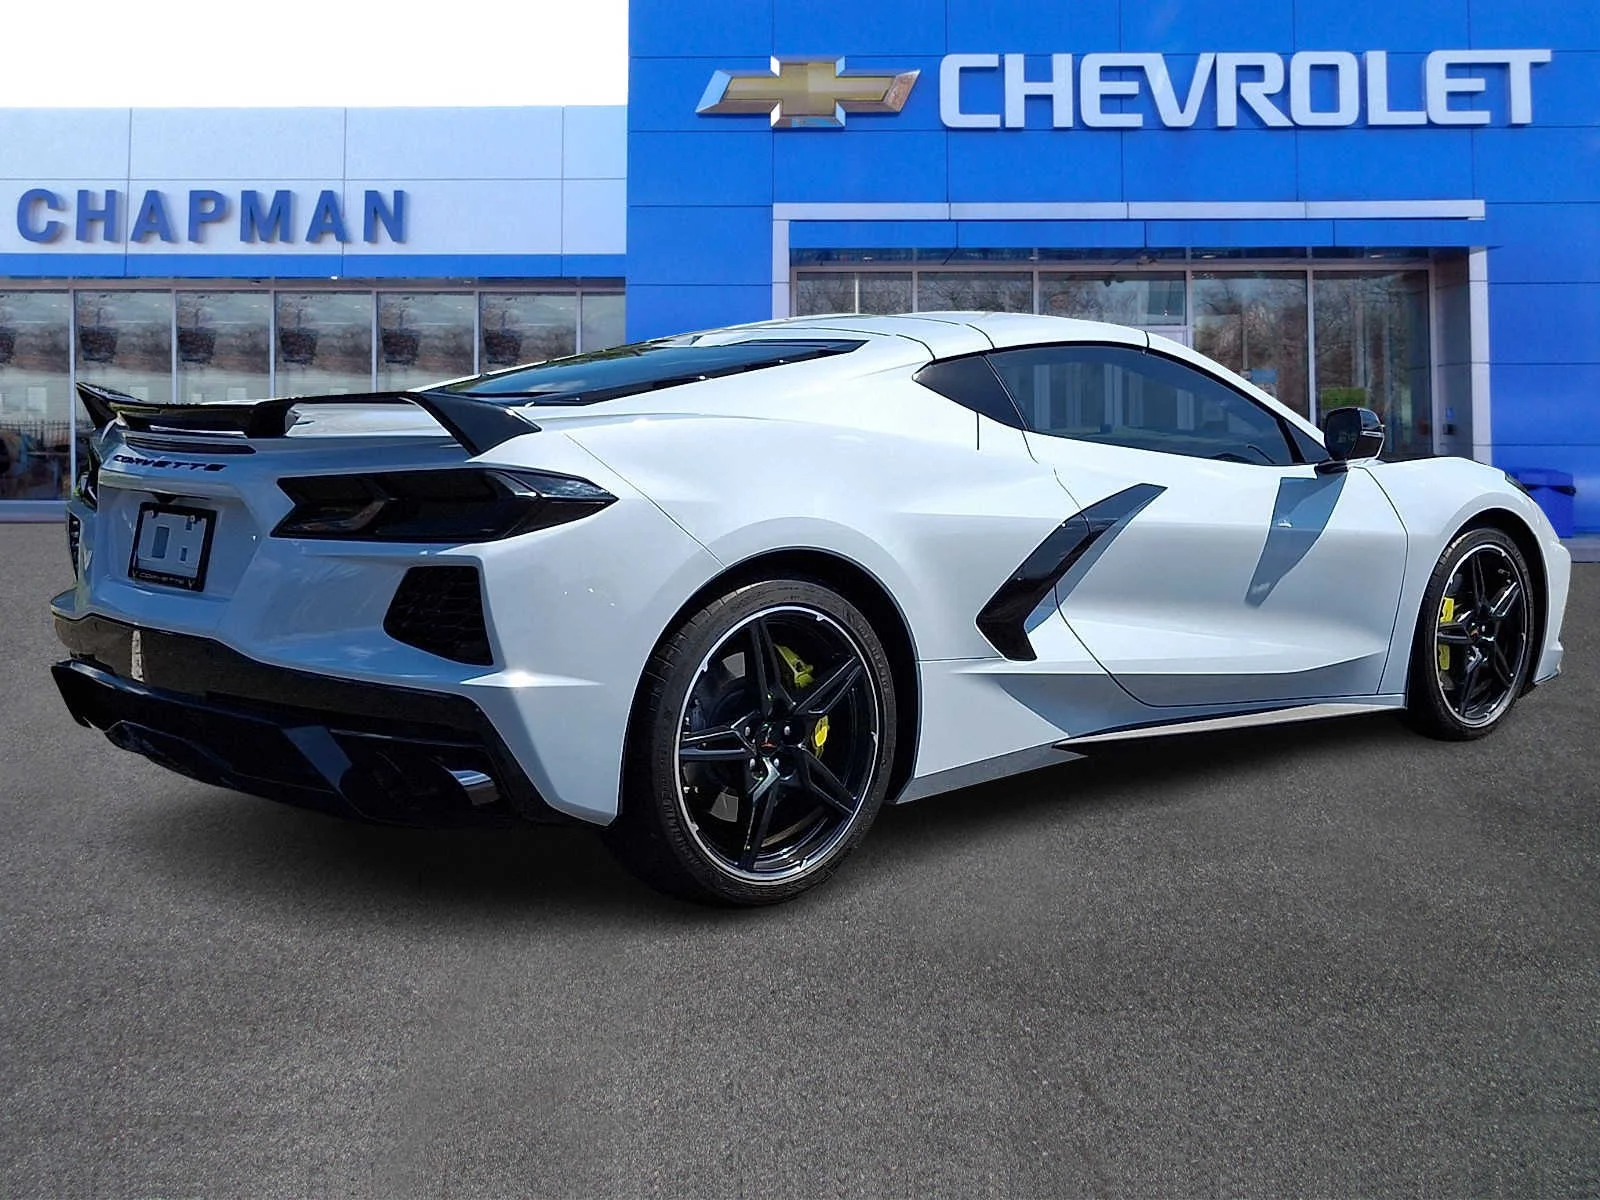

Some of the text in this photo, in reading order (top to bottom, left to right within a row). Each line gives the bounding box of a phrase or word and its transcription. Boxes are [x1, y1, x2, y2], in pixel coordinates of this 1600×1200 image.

[938, 49, 1552, 129] CHEVROLET
[16, 189, 407, 243] CHAPMAN
[113, 454, 227, 471] CORVETTE
